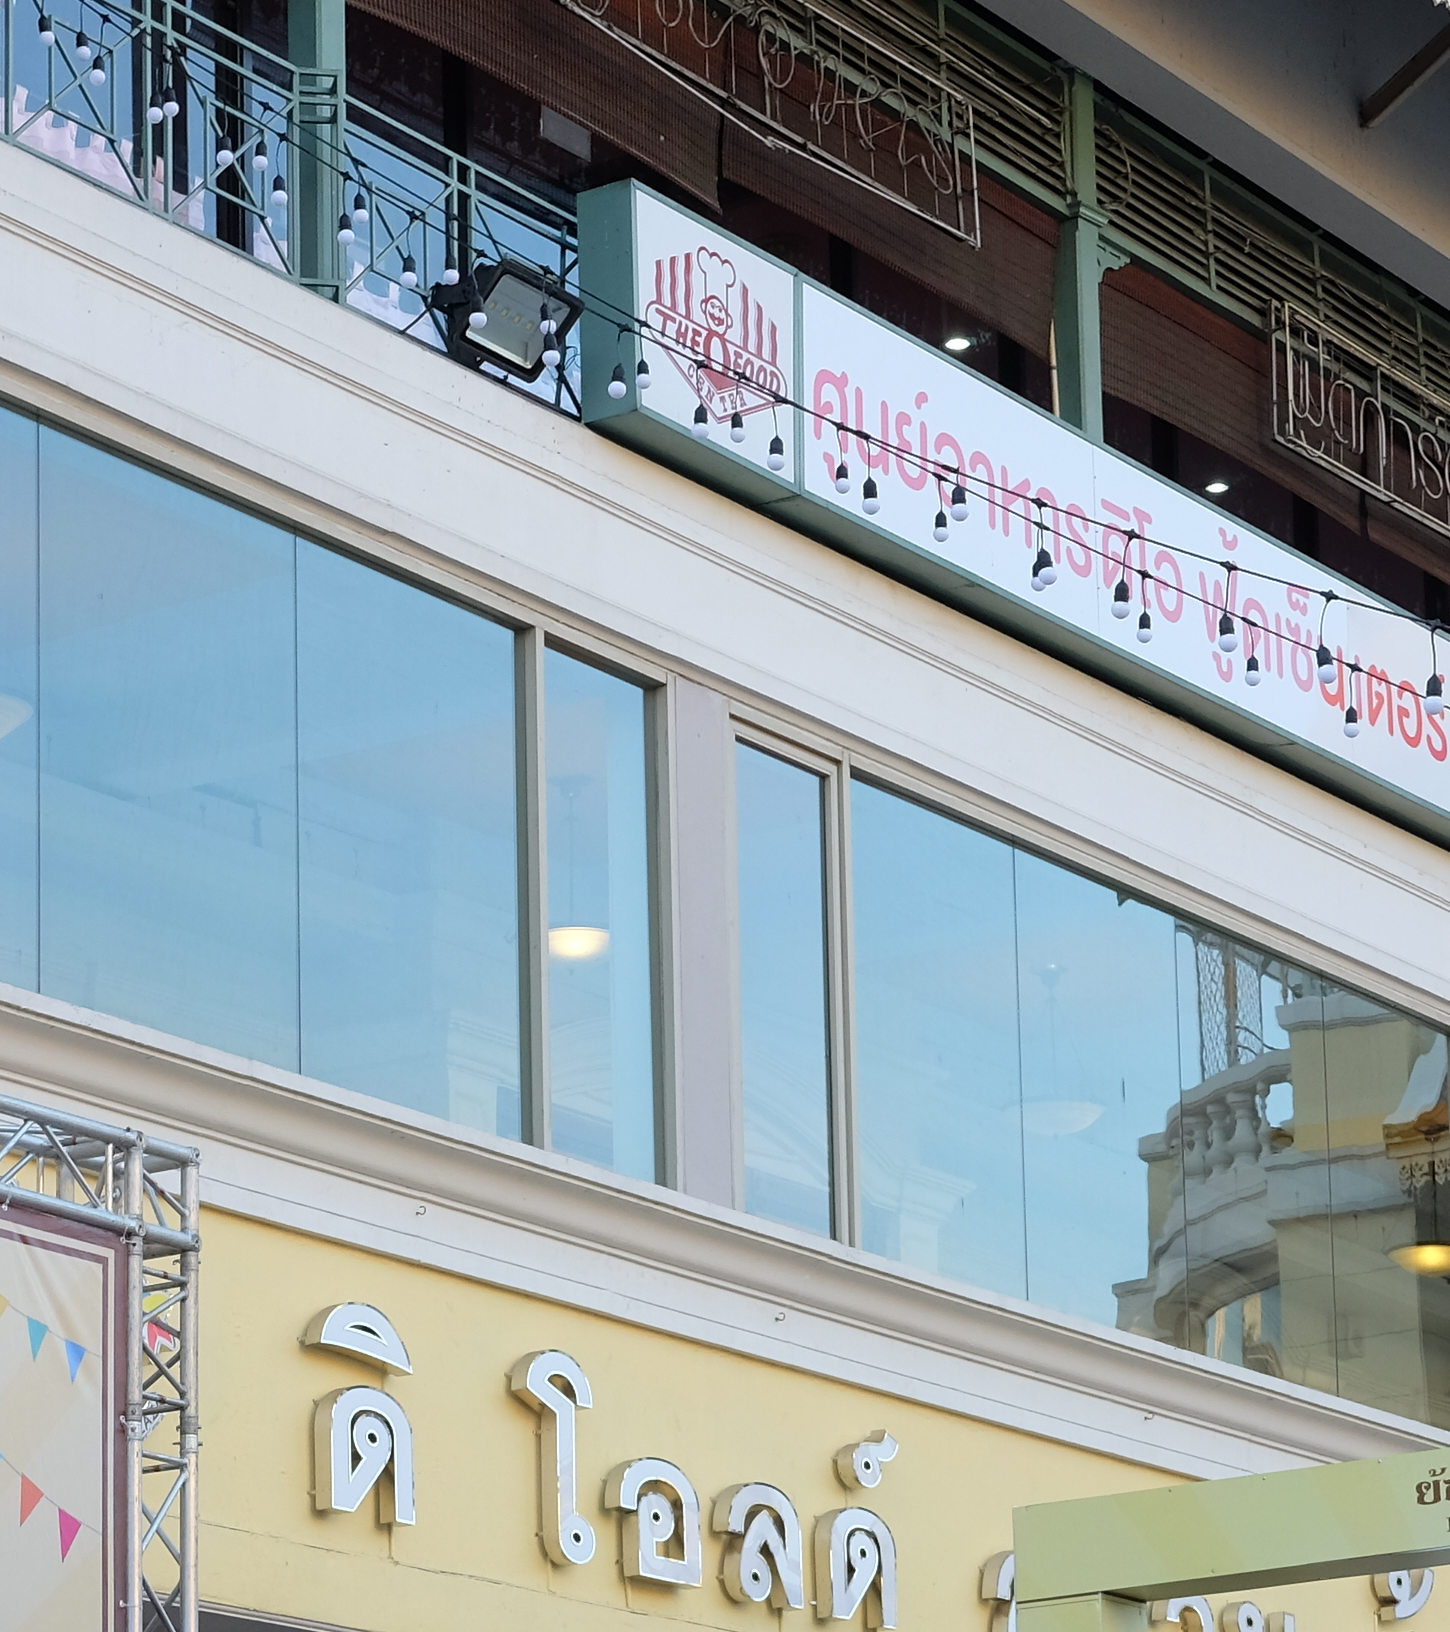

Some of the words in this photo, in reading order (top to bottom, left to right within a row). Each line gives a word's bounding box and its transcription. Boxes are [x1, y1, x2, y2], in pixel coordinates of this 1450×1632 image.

[654, 307, 703, 357] THE
[732, 350, 782, 395] FOOD
[509, 1348, 899, 1631] โอลด์
